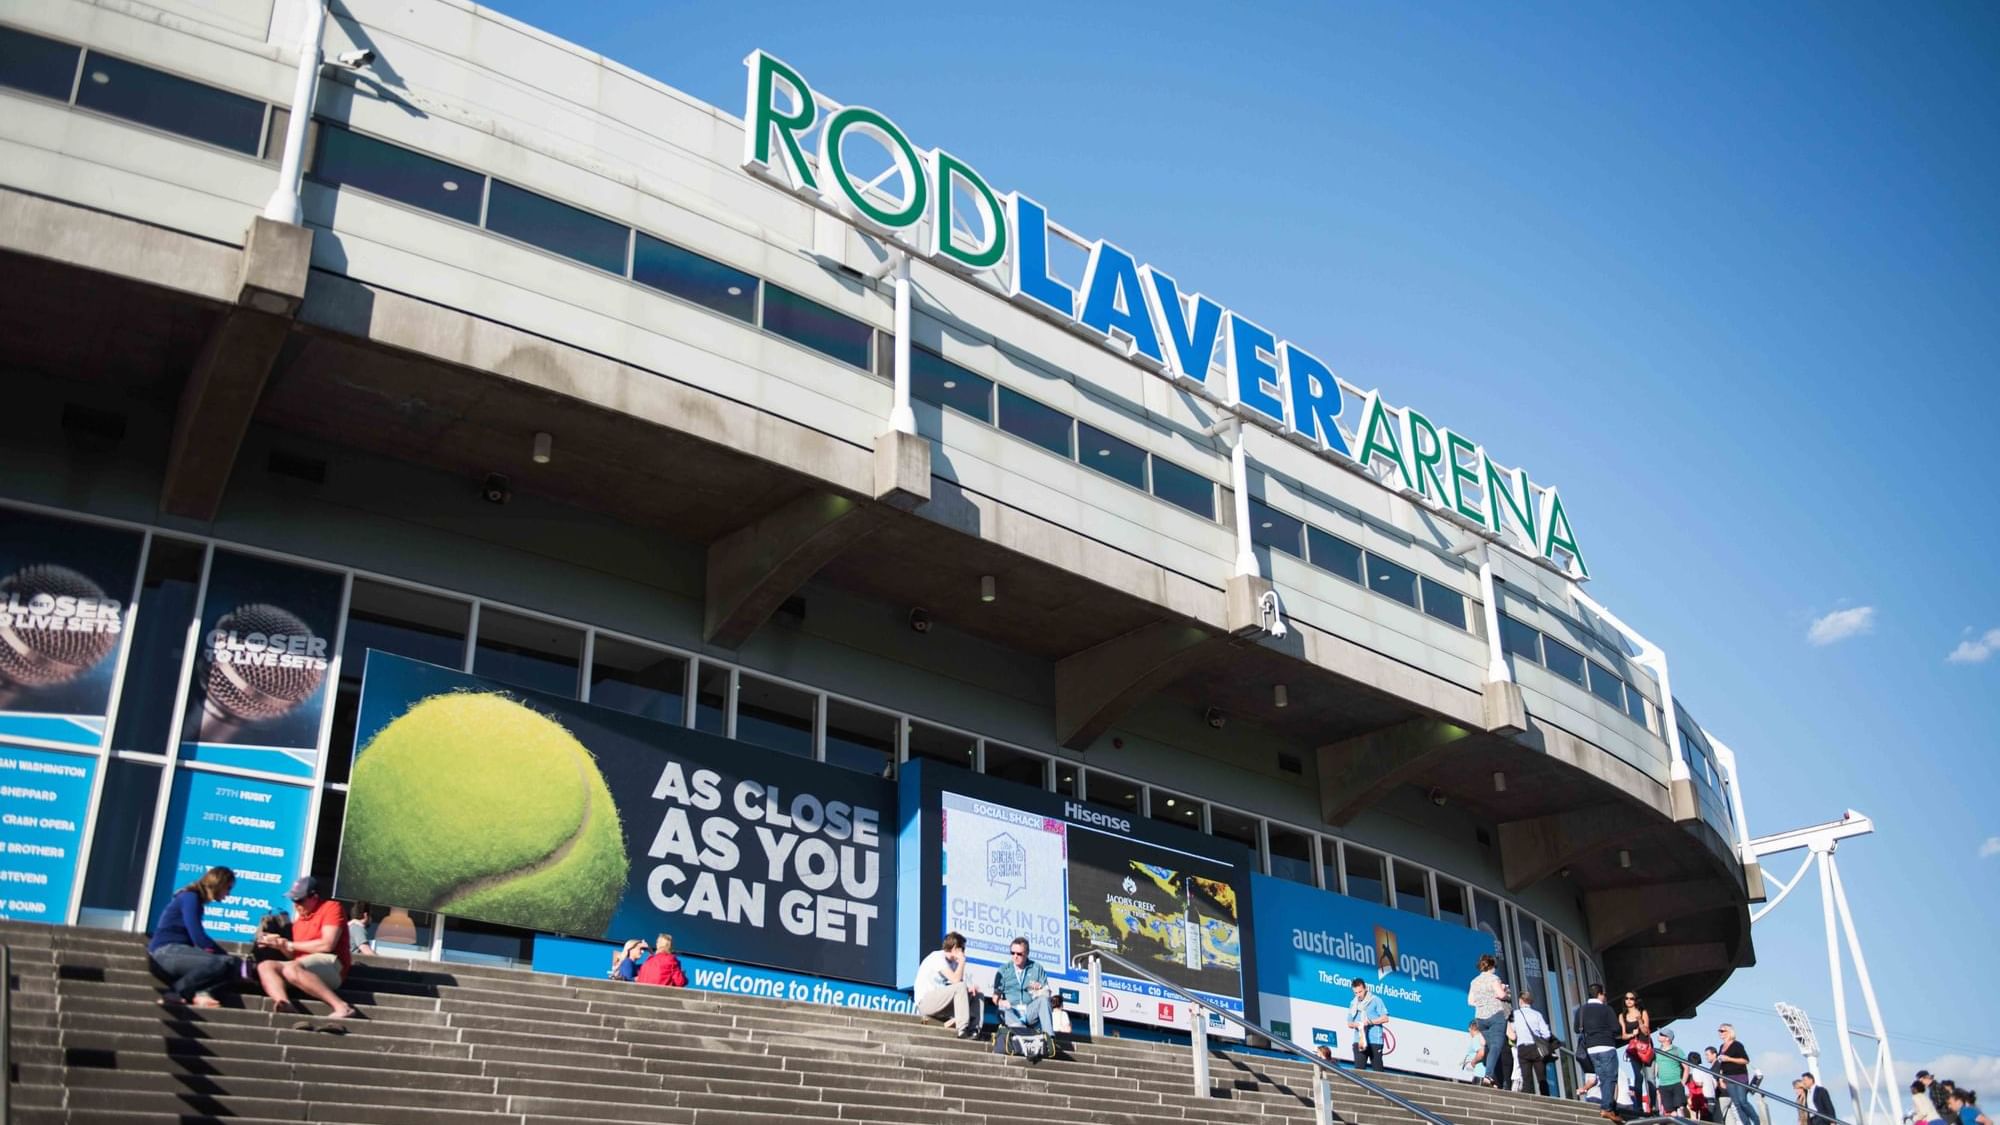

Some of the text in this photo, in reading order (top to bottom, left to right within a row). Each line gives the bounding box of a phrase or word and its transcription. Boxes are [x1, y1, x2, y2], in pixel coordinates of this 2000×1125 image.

[744, 49, 1592, 582] ROD LAVER ARENA
[16, 614, 65, 630] LIVE
[66, 617, 121, 634] SETS
[206, 629, 327, 656] CLOSER
[234, 652, 280, 666] LIVE
[280, 655, 327, 670] SETS
[19, 760, 86, 777] WASHINGTON
[651, 761, 879, 847] AS CLOSE
[973, 803, 1009, 820] SOCIAL
[1009, 811, 1041, 828] SHACK
[1064, 801, 1131, 832] Hisense
[3, 814, 75, 832] CRASH OPERA
[7, 842, 65, 858] BROTHERS
[211, 839, 231, 850] THE
[647, 806, 880, 899] AS YOU
[8, 900, 46, 912] SOUND
[647, 864, 878, 946] CAN GET
[951, 898, 1060, 935] CHECK IN TO
[952, 917, 975, 932] THE
[1024, 932, 1060, 948] SHACK
[1292, 928, 1440, 982] australian open
[695, 967, 785, 998] welcome
[788, 980, 809, 1001] to
[812, 981, 842, 1005] the
[1318, 970, 1333, 983] The
[1333, 973, 1352, 987] Gran
[1375, 982, 1384, 994] of
[1384, 985, 1422, 1003] Asia-Pacific
